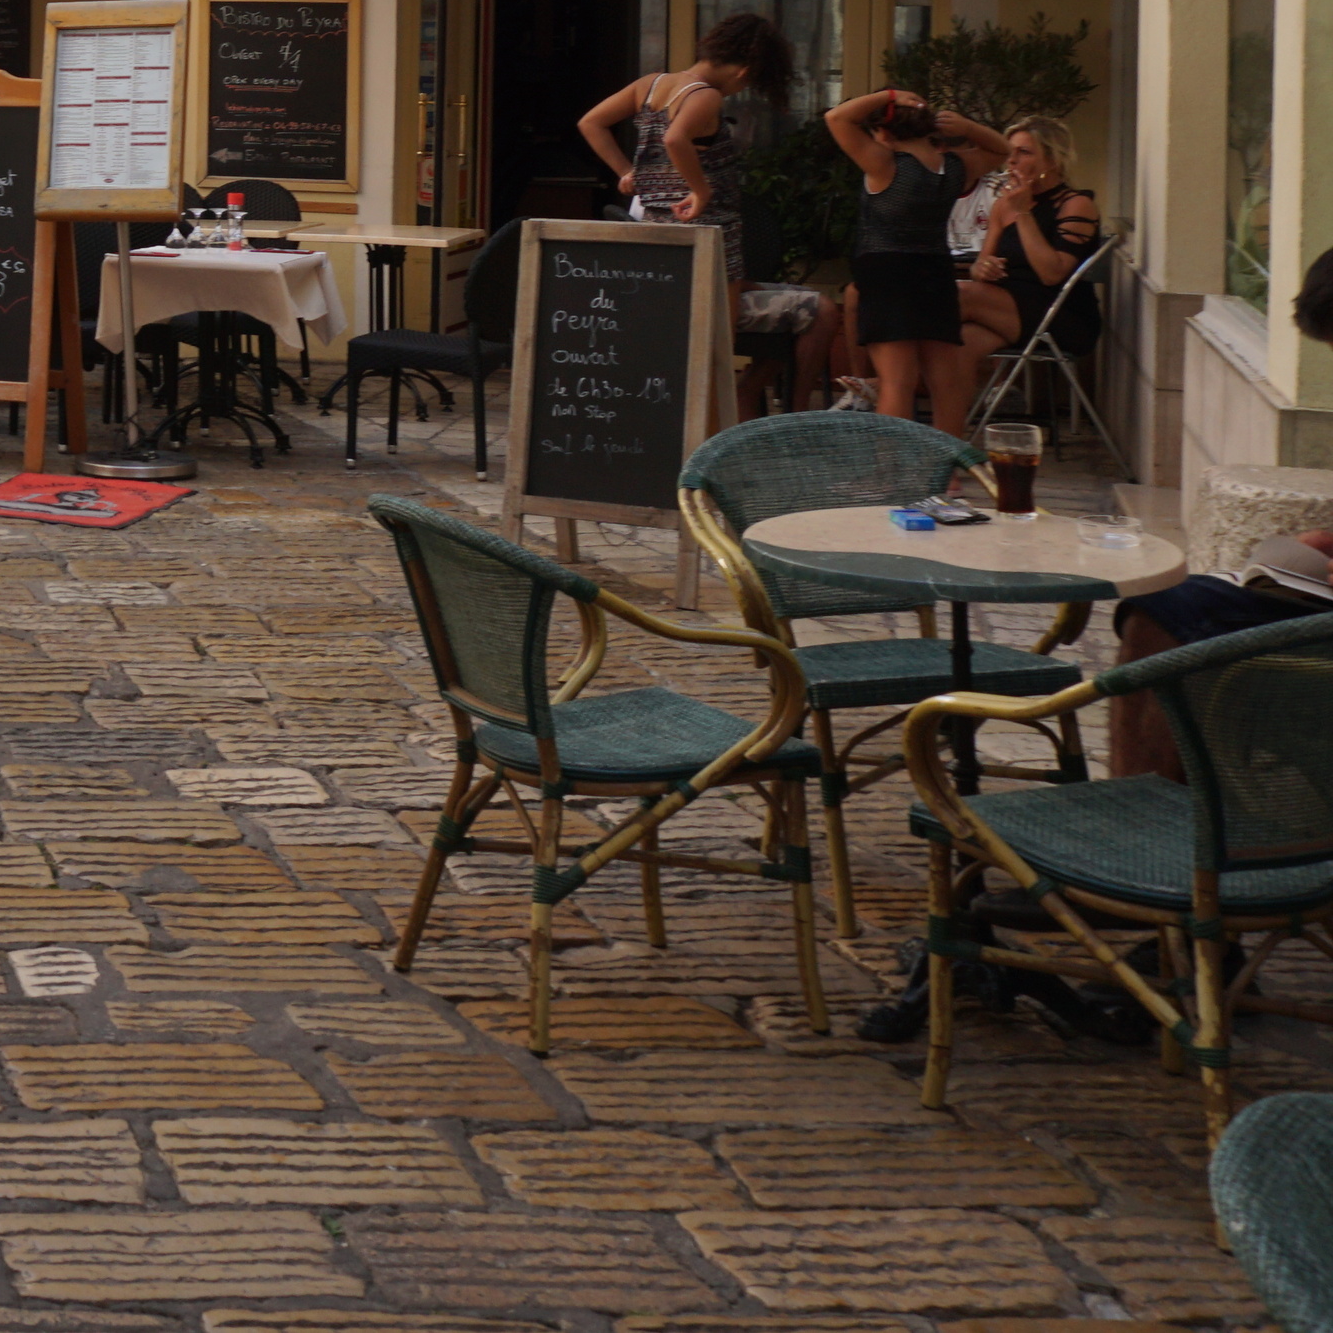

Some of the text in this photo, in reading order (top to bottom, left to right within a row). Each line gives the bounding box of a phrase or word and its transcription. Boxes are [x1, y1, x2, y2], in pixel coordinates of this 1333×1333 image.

[553, 252, 675, 295] Boulangerie
[589, 288, 618, 312] du
[547, 377, 569, 397] de
